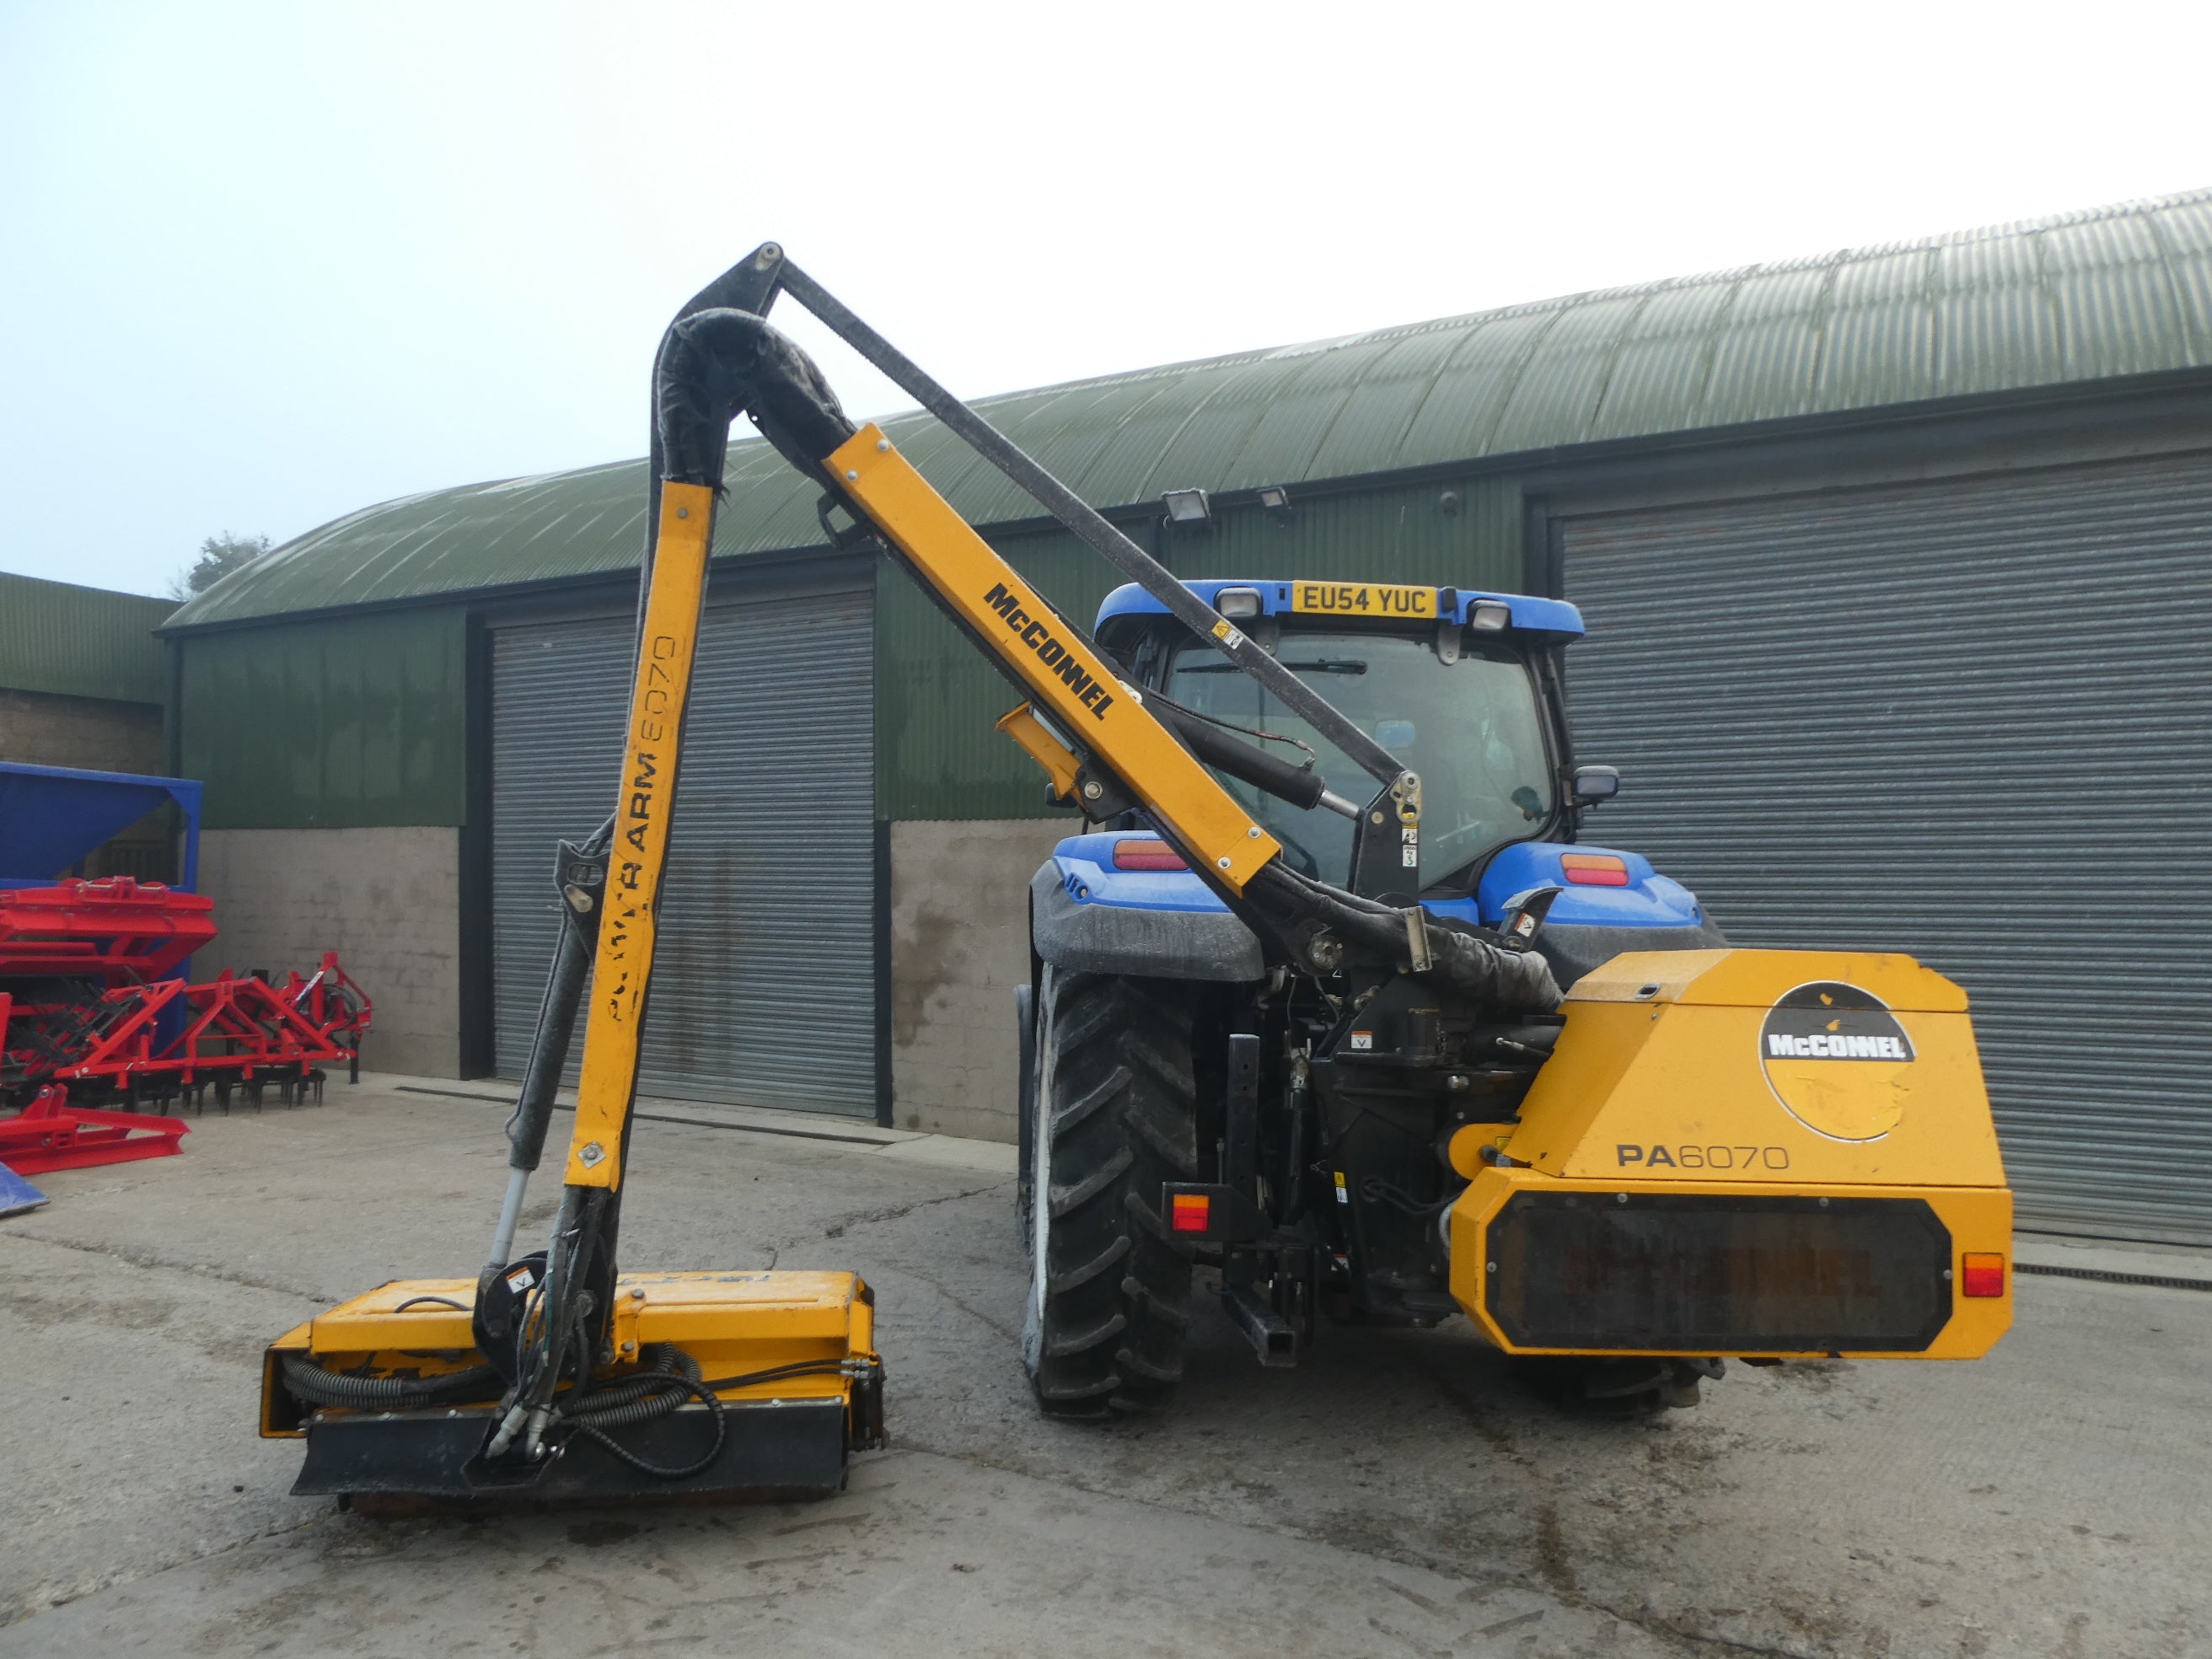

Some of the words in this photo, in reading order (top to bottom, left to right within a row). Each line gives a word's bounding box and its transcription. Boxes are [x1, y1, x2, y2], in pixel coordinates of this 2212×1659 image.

[1303, 585, 1370, 611] EU54
[1377, 588, 1427, 613] YUC
[1615, 1144, 1790, 1170] PA6070
